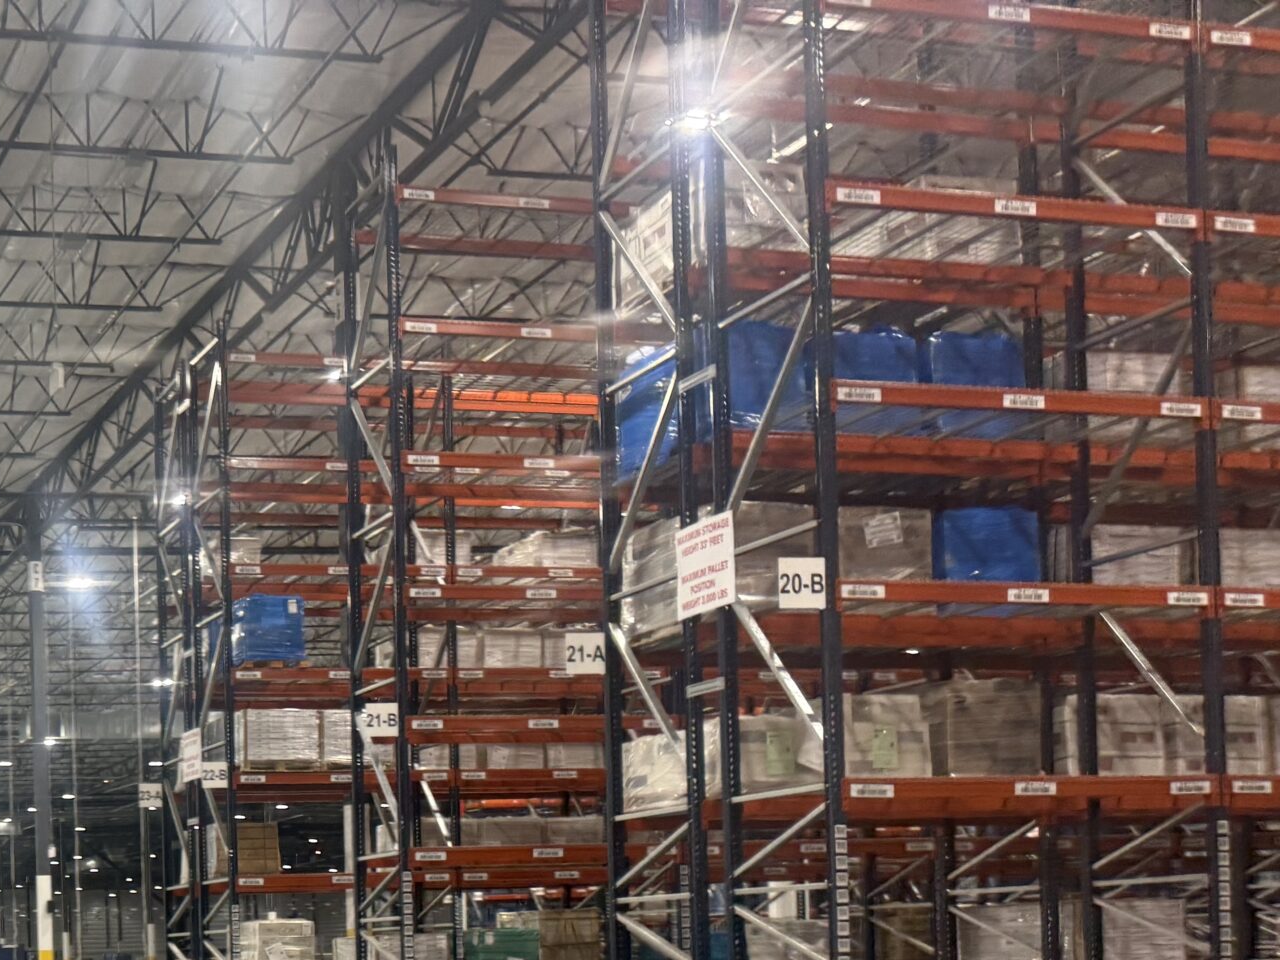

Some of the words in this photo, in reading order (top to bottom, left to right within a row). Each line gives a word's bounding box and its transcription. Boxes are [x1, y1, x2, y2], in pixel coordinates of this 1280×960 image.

[709, 533, 724, 546] FEET
[708, 560, 728, 574] PALLET
[690, 579, 716, 596] POSITION
[780, 573, 824, 594] 20-B
[717, 588, 728, 600] LBS
[567, 644, 605, 662] 21-A
[366, 713, 397, 727] 21-B
[202, 769, 227, 780] 22-B
